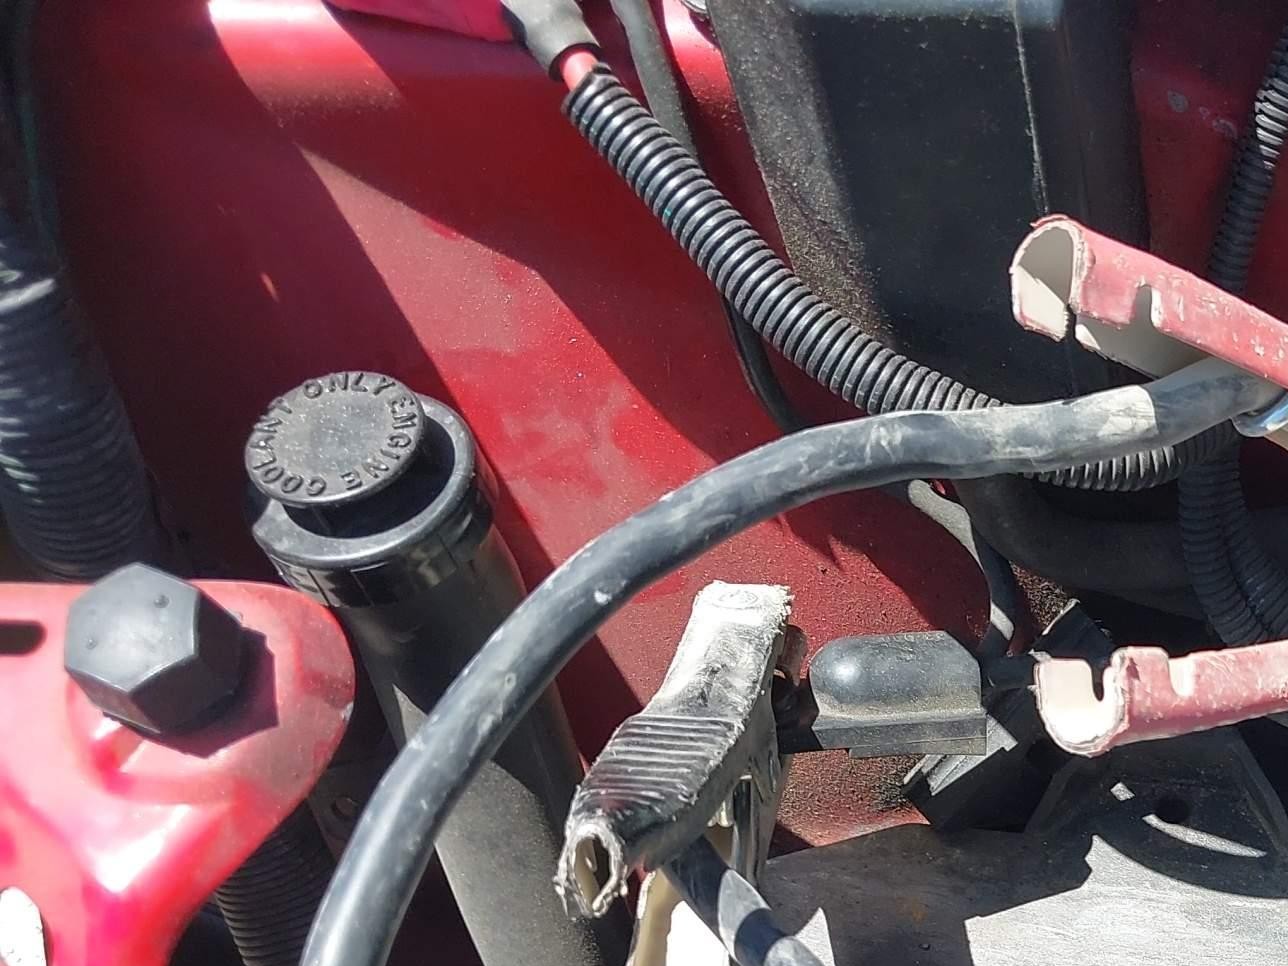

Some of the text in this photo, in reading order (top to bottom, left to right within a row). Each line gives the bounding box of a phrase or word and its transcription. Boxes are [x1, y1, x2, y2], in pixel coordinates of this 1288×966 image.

[250, 373, 418, 497] ENGINE COOLANT ONLY
